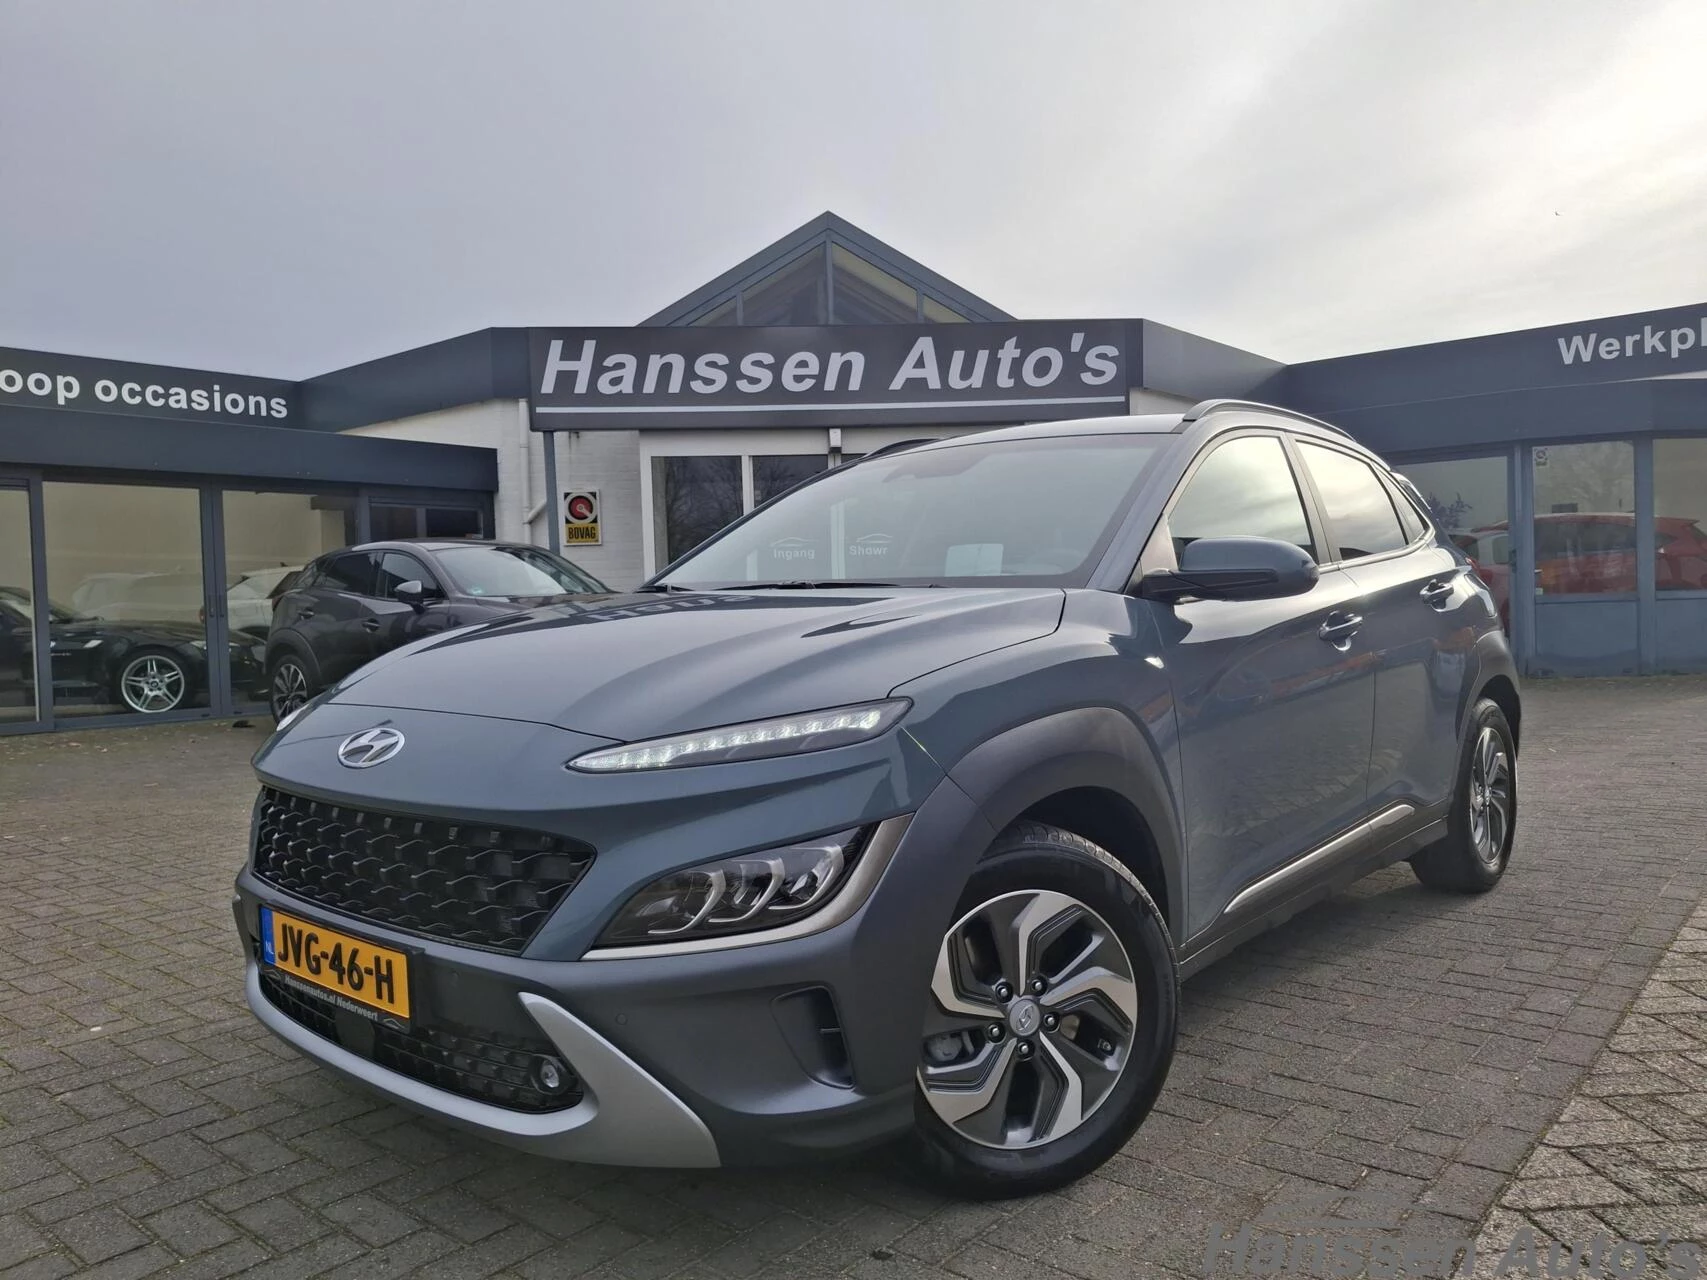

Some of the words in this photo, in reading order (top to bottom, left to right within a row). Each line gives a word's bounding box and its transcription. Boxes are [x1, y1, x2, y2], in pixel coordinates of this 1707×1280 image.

[540, 339, 865, 394] Hanssen
[889, 332, 1119, 390] Auto's
[94, 379, 288, 418] occasions
[568, 526, 596, 540] BOVAG
[773, 548, 816, 561] Ingang
[278, 923, 395, 1004] JVG-46-H
